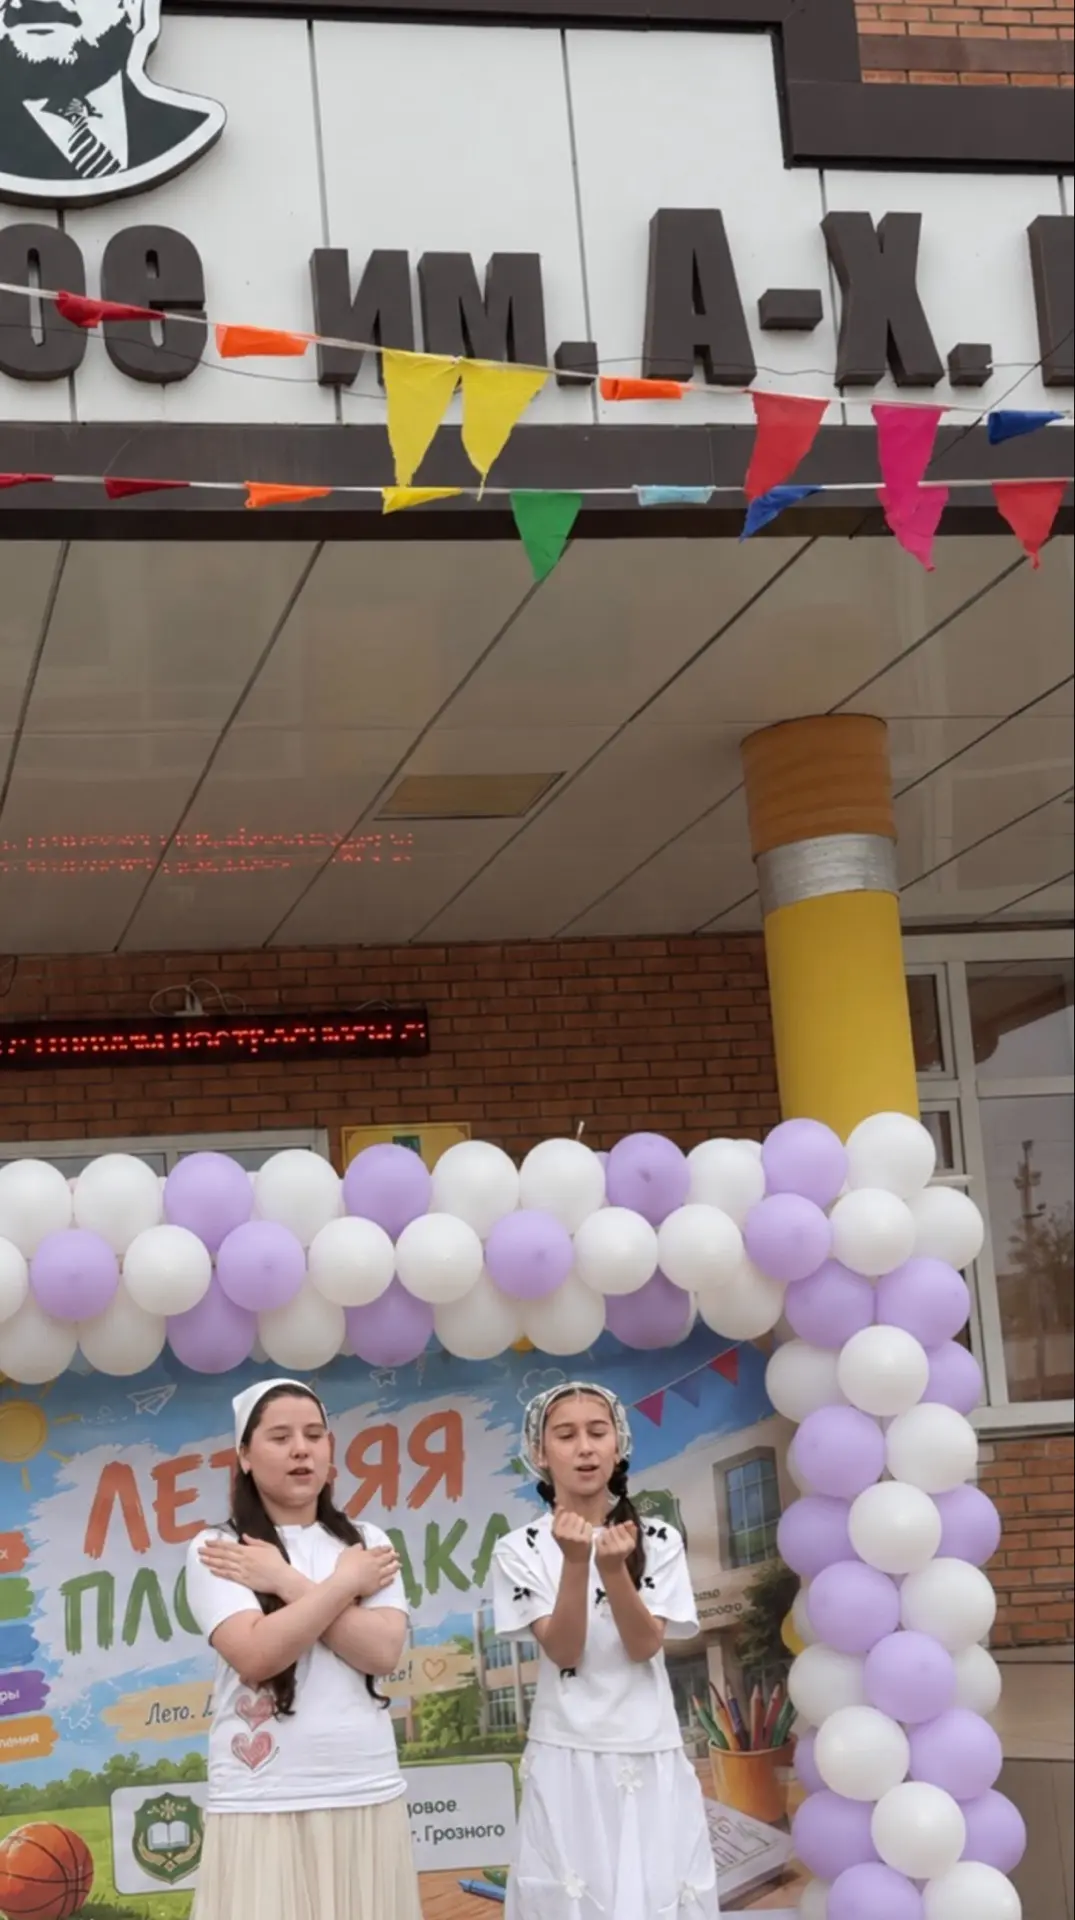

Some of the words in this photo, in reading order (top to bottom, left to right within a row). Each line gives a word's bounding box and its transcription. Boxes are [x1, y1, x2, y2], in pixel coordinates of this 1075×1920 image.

[145, 1702, 195, 1726] Лето.
[407, 1800, 457, 1819] овое
[425, 1824, 505, 1845] Грозного
